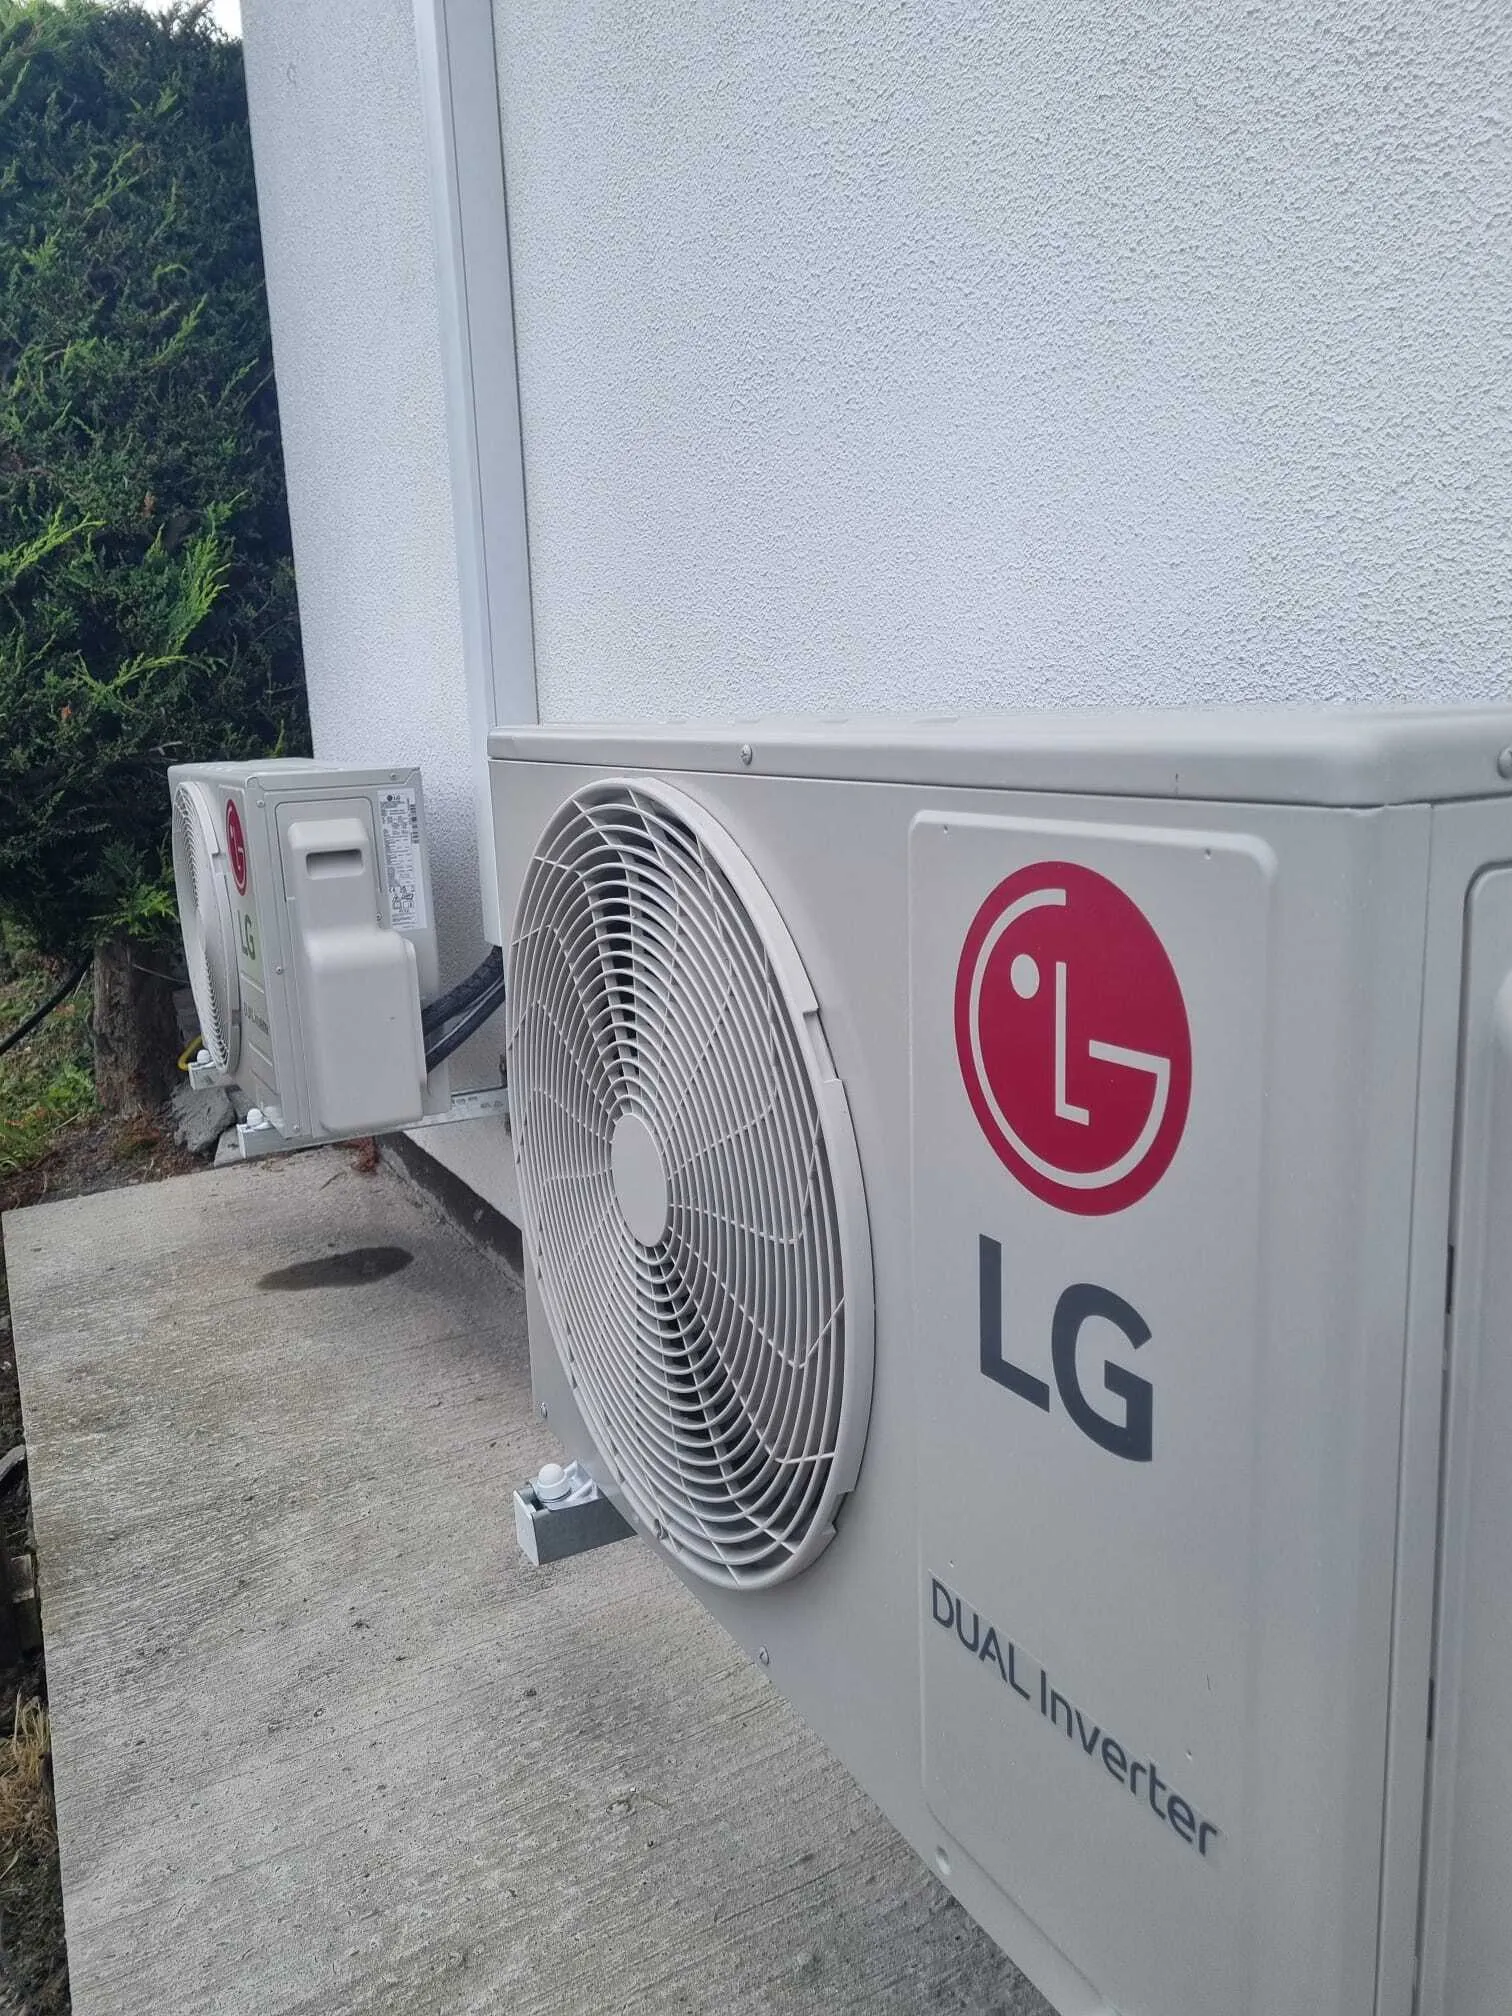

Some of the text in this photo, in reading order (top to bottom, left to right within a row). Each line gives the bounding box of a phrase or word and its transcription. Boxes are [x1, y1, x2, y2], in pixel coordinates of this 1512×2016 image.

[238, 910, 256, 960] LG
[979, 1233, 1153, 1462] LG
[932, 1577, 1218, 1857] DUAL Inverter
